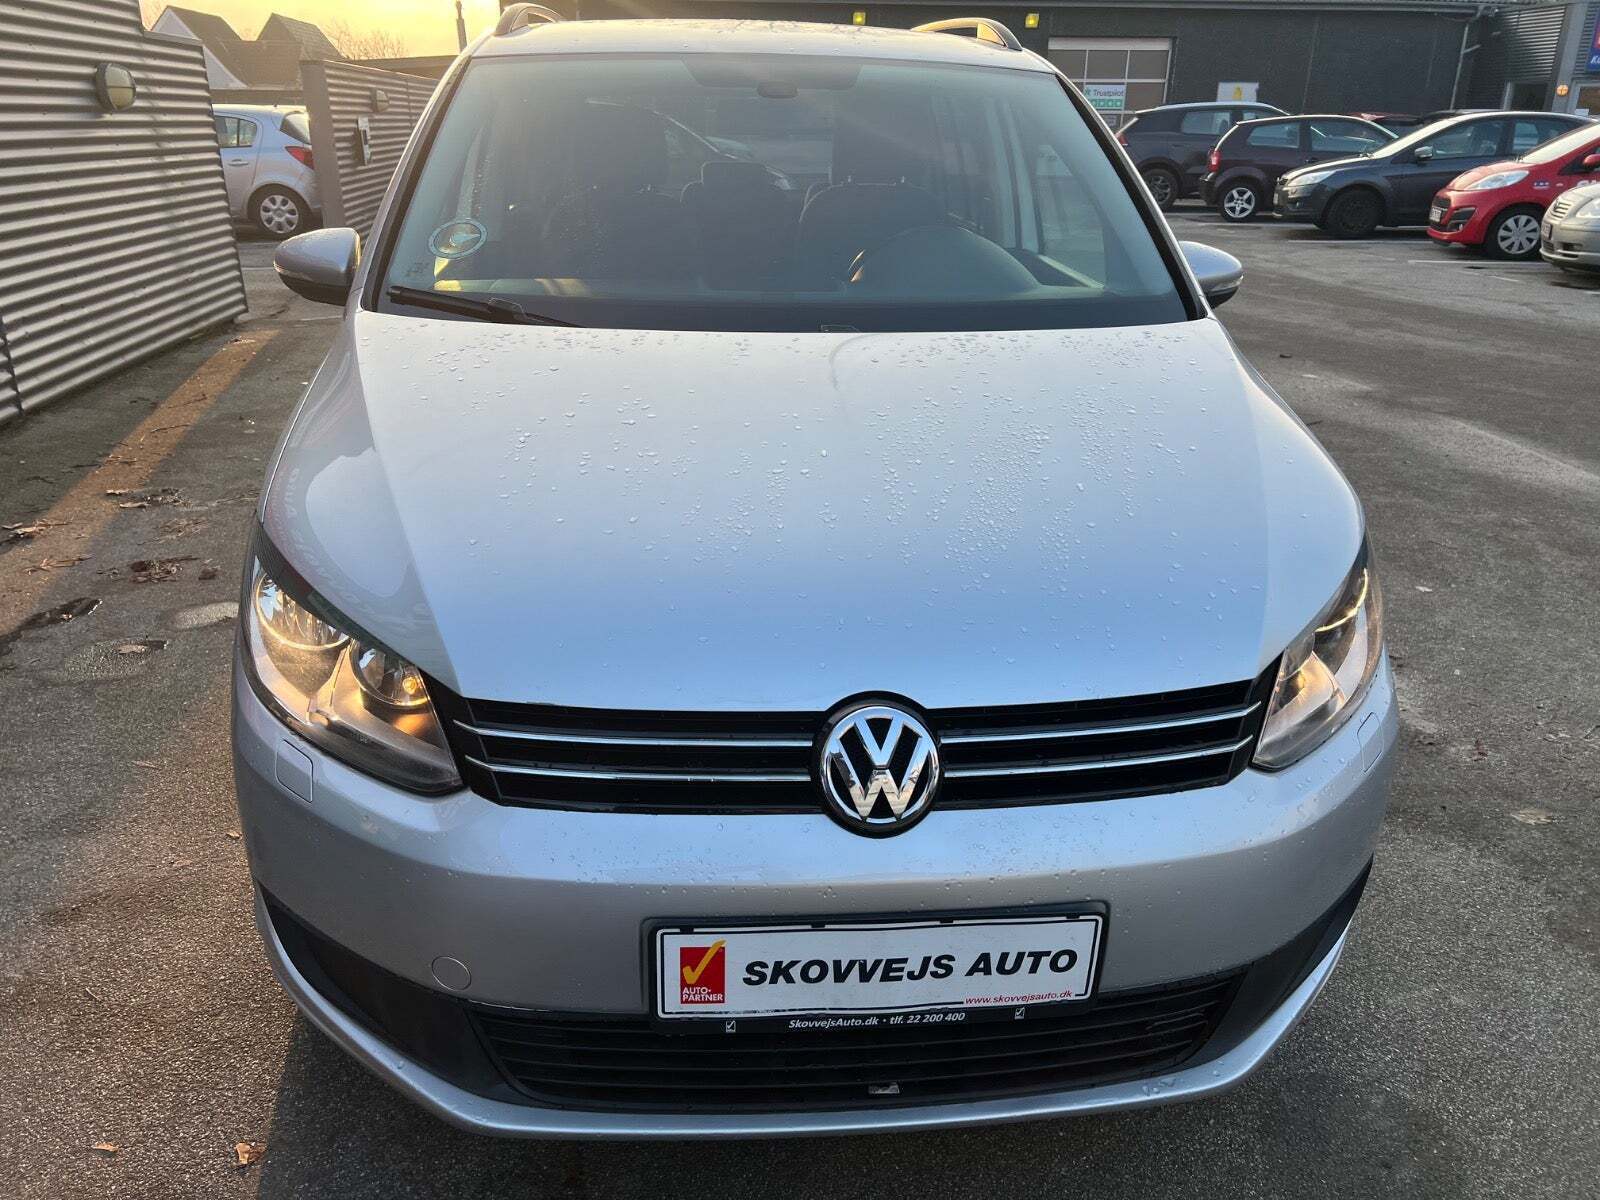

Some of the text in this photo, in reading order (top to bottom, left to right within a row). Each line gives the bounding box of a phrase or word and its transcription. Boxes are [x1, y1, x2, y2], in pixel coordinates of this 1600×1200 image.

[1093, 87, 1124, 97] Trustpilot
[743, 949, 1078, 986] SKOVVEJS AUTO
[682, 993, 724, 1002] PARTNER
[965, 990, 1073, 1005] www.skovvejsauto.dk
[788, 1012, 966, 1029] SkovvejsAuto.dk tlf. 22 200 400
